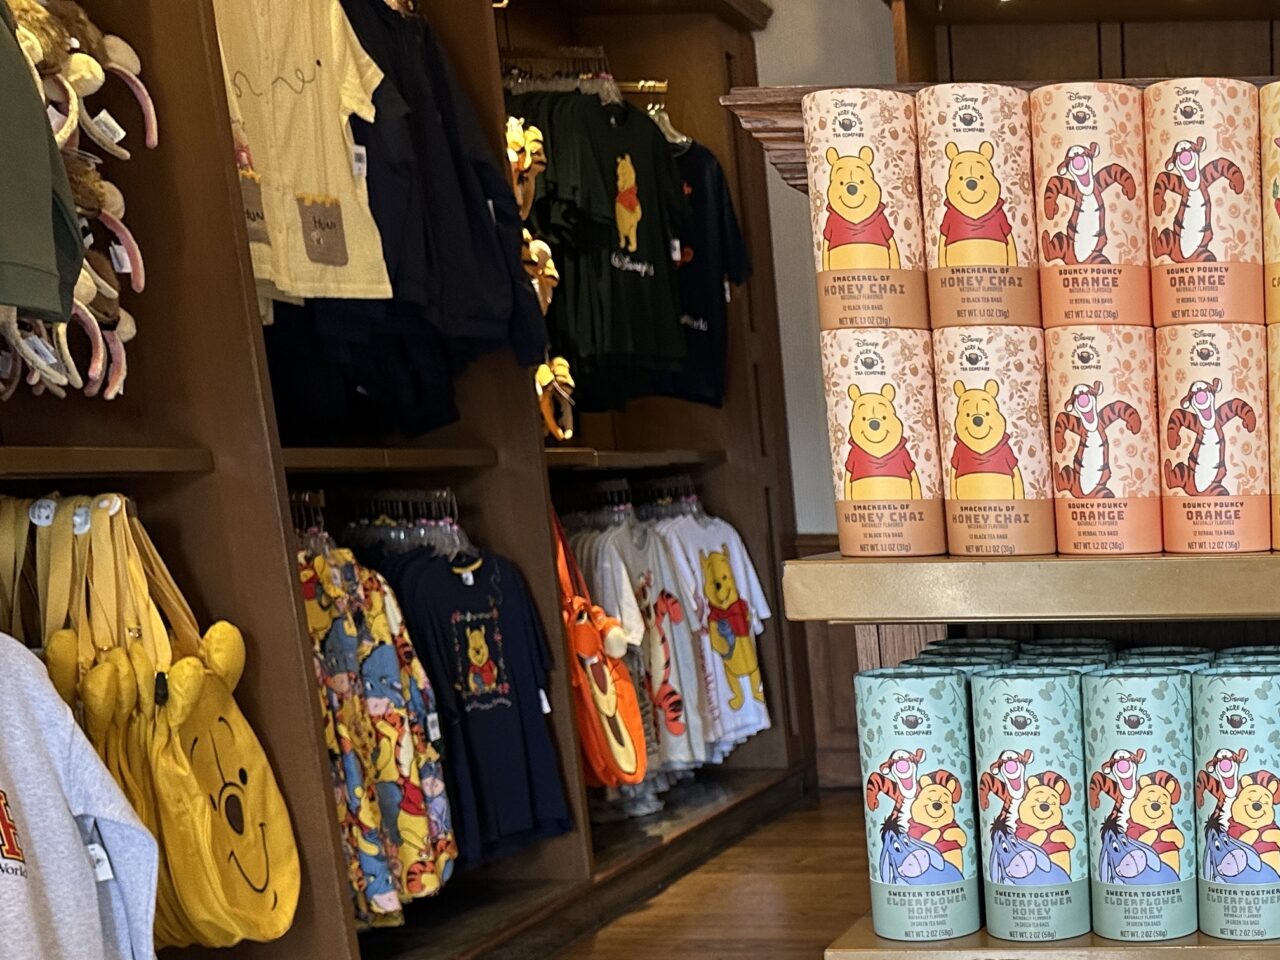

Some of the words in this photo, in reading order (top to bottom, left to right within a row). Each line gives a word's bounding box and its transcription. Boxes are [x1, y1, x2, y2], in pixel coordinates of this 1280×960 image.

[941, 277, 985, 288] HONEY
[991, 276, 1023, 287] CHAI
[1063, 277, 1119, 288] ORANGE
[1170, 275, 1225, 287] ORANGE
[824, 284, 864, 296] HONEY
[869, 284, 905, 294] CHAI
[845, 512, 884, 523] HONEY
[890, 512, 924, 521] CHAI
[953, 515, 990, 524] HONEY
[995, 514, 1029, 523] CHAI
[1072, 511, 1124, 520] ORANGE
[1186, 510, 1241, 520] ORANGE
[888, 890, 923, 898] SWEETER
[925, 887, 964, 897] TOGETHER
[995, 890, 1027, 898] SWEETER
[1030, 890, 1069, 898] TOGETHER
[1142, 889, 1180, 897] TOGETHER
[1208, 887, 1238, 895] SWEETER
[887, 894, 967, 906] ELDERFLOWER
[994, 897, 1072, 907] ELDERFLOWER
[1105, 895, 1182, 906] ELDERFLOWER
[908, 906, 948, 915] HONEY
[1124, 906, 1163, 914] HONEY
[1224, 905, 1262, 913] HONEY
